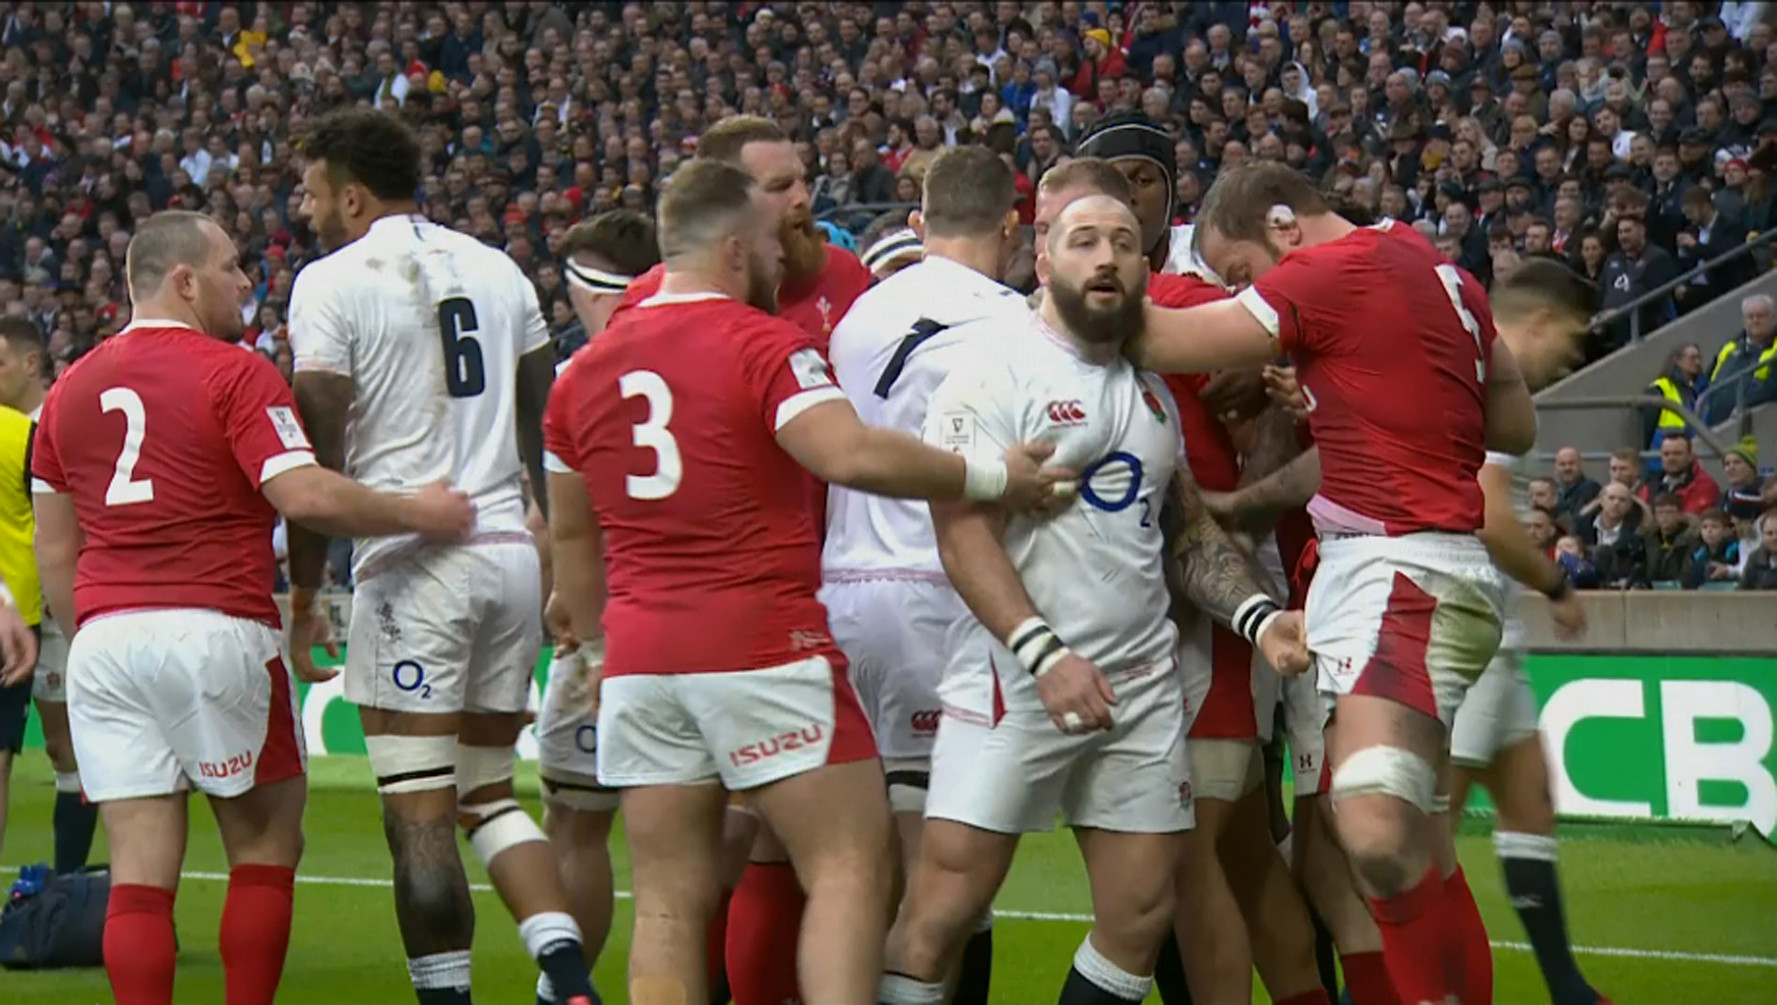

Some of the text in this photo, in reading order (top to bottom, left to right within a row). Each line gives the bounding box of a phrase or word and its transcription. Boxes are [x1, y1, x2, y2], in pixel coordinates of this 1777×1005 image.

[439, 297, 486, 397] 6
[100, 387, 154, 506] 2
[619, 370, 683, 500] 3
[392, 659, 432, 700] O2
[198, 749, 253, 778] ISUZU
[727, 723, 823, 768] ISUZU
[1538, 677, 1777, 838] CB
